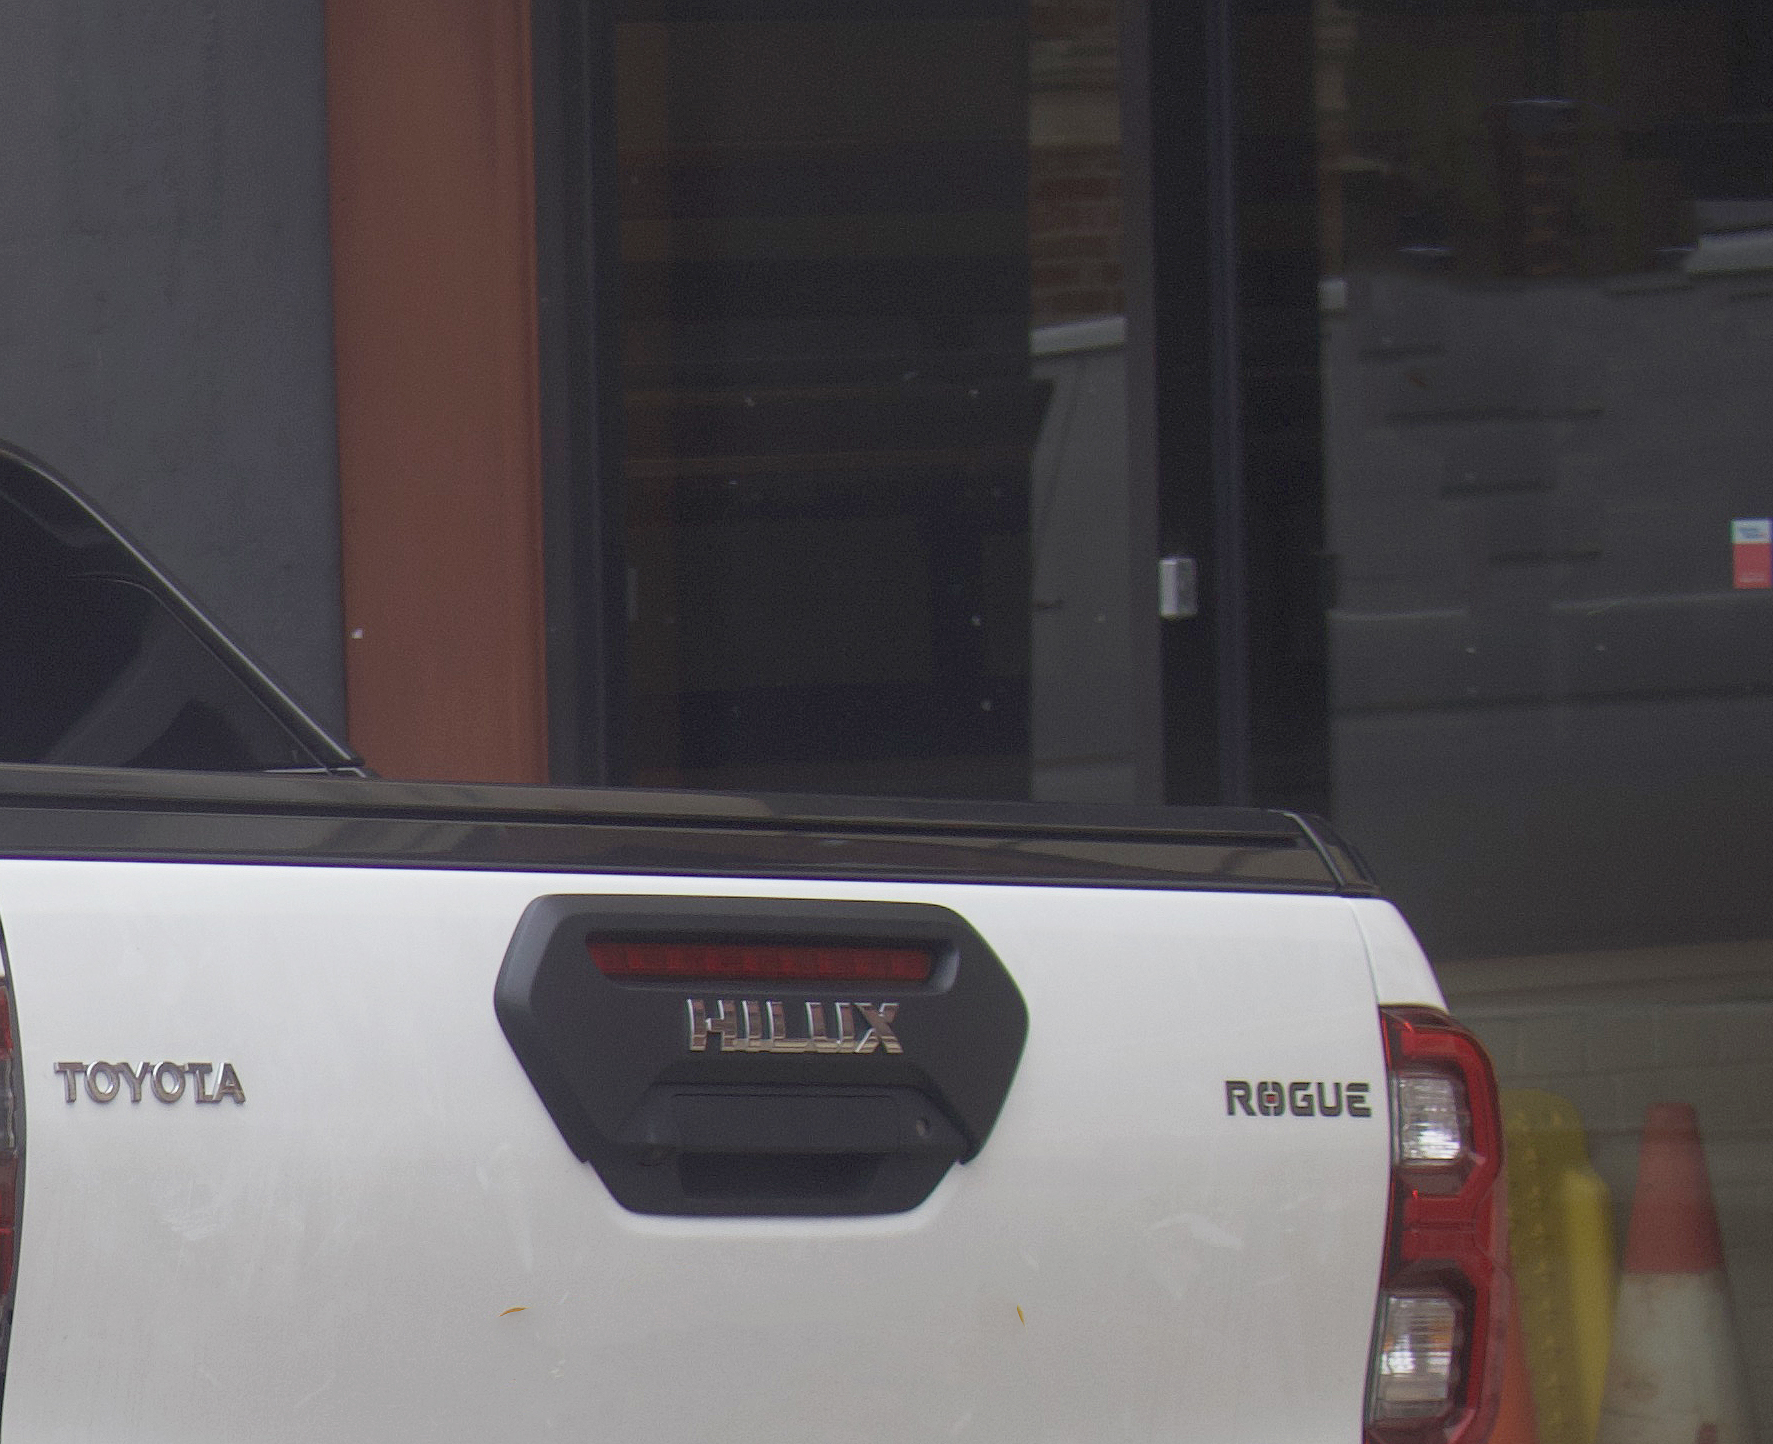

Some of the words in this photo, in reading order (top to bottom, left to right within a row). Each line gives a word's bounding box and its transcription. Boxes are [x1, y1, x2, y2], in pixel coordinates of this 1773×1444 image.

[685, 998, 903, 1055] HILUX
[53, 1060, 247, 1105] TOYOTA
[1224, 1079, 1373, 1119] ROGUE
